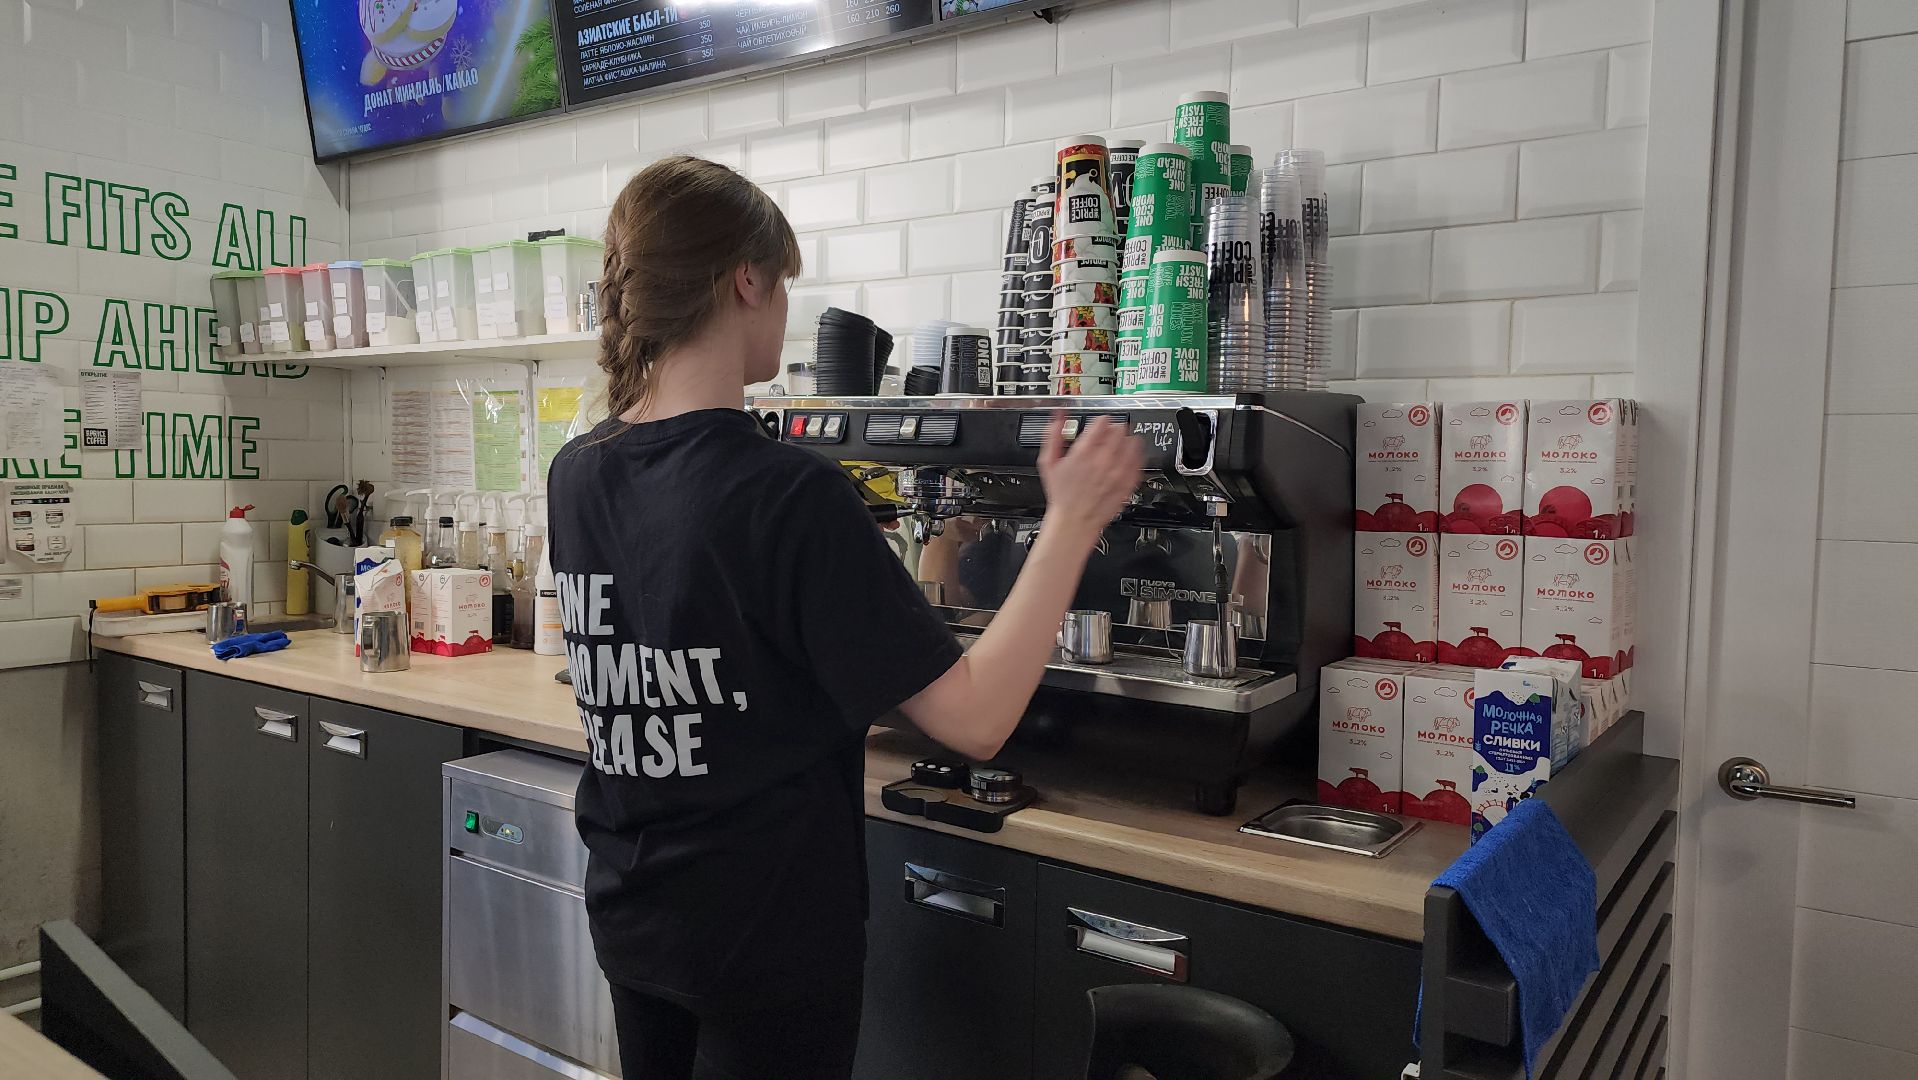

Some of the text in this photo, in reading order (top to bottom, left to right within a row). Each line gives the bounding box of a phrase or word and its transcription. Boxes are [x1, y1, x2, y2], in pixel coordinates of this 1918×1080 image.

[847, 13, 860, 24] 160
[865, 9, 880, 20] 210
[885, 4, 900, 15] 260
[577, 17, 630, 46] АЗИАТСКИЕ
[580, 48, 598, 60] ЛАТТЕ
[600, 34, 655, 54] ЯБЛОКО-ЖАСМИН
[702, 48, 714, 58] 350
[582, 34, 712, 73] КАРКАДЕ-КЛУБНИКА 350
[363, 92, 393, 117] ДОНАТ
[1180, 104, 1204, 116] TASTE
[1186, 126, 1203, 138] ONE
[1157, 157, 1186, 169] AHEAD
[1162, 168, 1186, 181] JUMP
[1169, 179, 1185, 191] ONE
[1071, 197, 1099, 209] COFFEE
[46, 171, 191, 260] FITS
[1071, 207, 1095, 221] PRICE
[1133, 204, 1155, 216] COOL
[1135, 215, 1153, 227] ONE
[1179, 265, 1204, 277] TASTE
[1176, 276, 1203, 288] FRESH
[1126, 287, 1145, 298] ONE
[1187, 288, 1203, 299] ONE
[1149, 304, 1164, 315] ONE
[1146, 326, 1162, 338] ONE
[977, 338, 990, 367] ONE
[1174, 348, 1199, 359] LOVE
[1178, 359, 1199, 370] NEW
[1178, 369, 1199, 382] ONE
[1134, 422, 1175, 434] APPIA
[1368, 451, 1419, 459] МОЛОКО
[1454, 451, 1506, 459] МОЛОКО
[1541, 451, 1598, 460] МОЛОКО
[1141, 579, 1176, 588] nuova
[1366, 579, 1417, 588] МОЛОКО
[1452, 583, 1506, 593] МОЛОКО
[1537, 587, 1595, 599] МОЛОКО
[554, 572, 615, 636] ONE
[1332, 720, 1386, 734] МОЛОКО
[1417, 730, 1474, 745] МОЛОКО
[1482, 735, 1541, 752] СЛИВКИ
